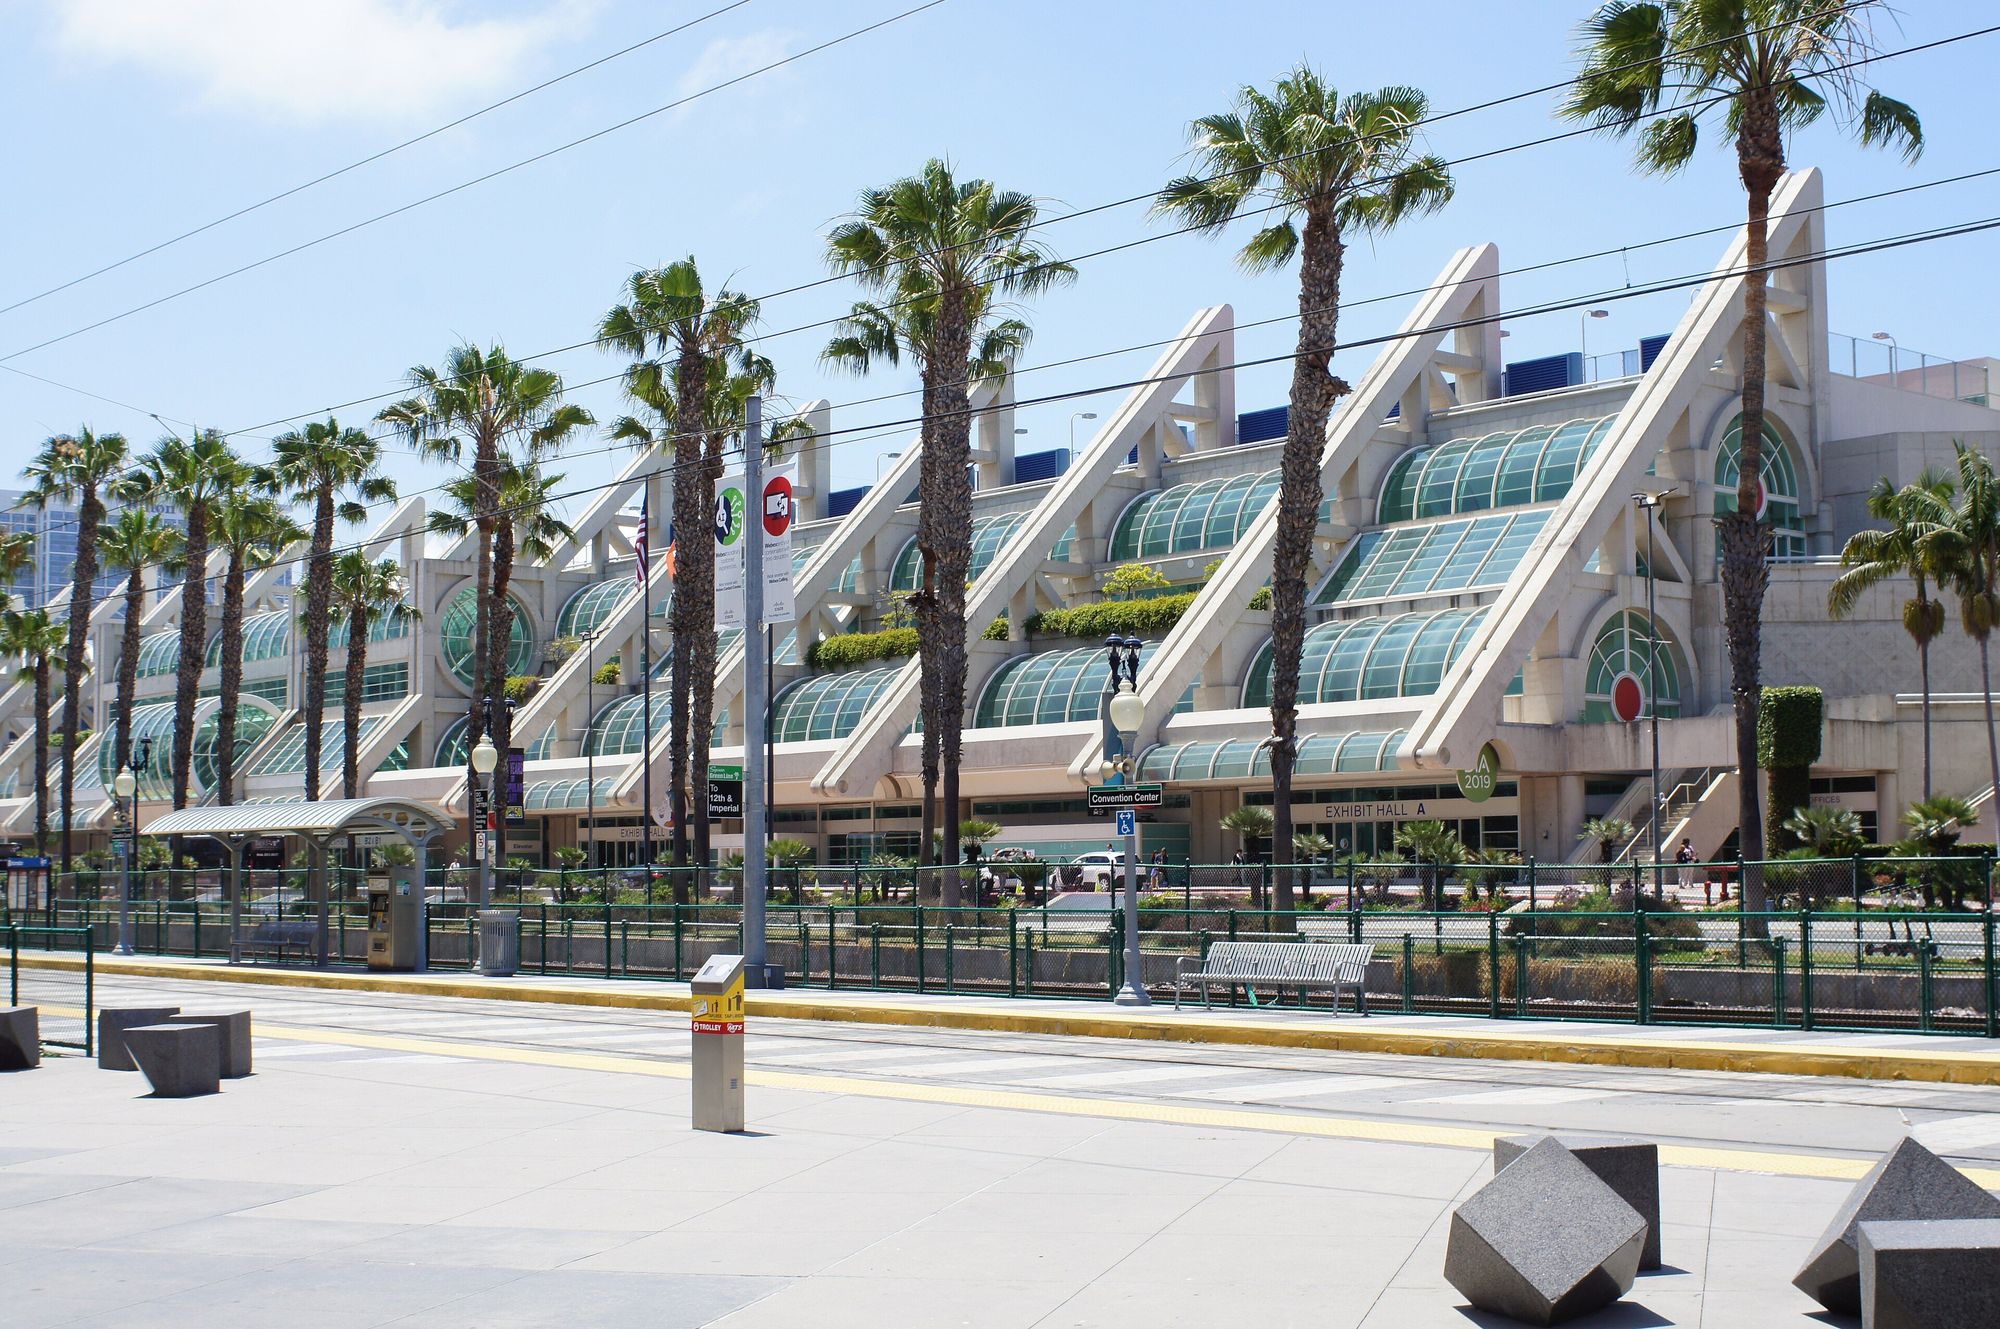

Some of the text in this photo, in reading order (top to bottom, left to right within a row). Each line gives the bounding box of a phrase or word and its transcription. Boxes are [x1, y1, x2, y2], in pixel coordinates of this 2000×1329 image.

[1465, 774, 1490, 789] 2019
[710, 784, 719, 792] To
[710, 794, 733, 802] 12th &
[1092, 793, 1159, 803] Convention Center
[710, 804, 739, 813] Imperial
[1325, 802, 1426, 818] EXHIBIT HALL A
[699, 1023, 721, 1031] TROLLEY
